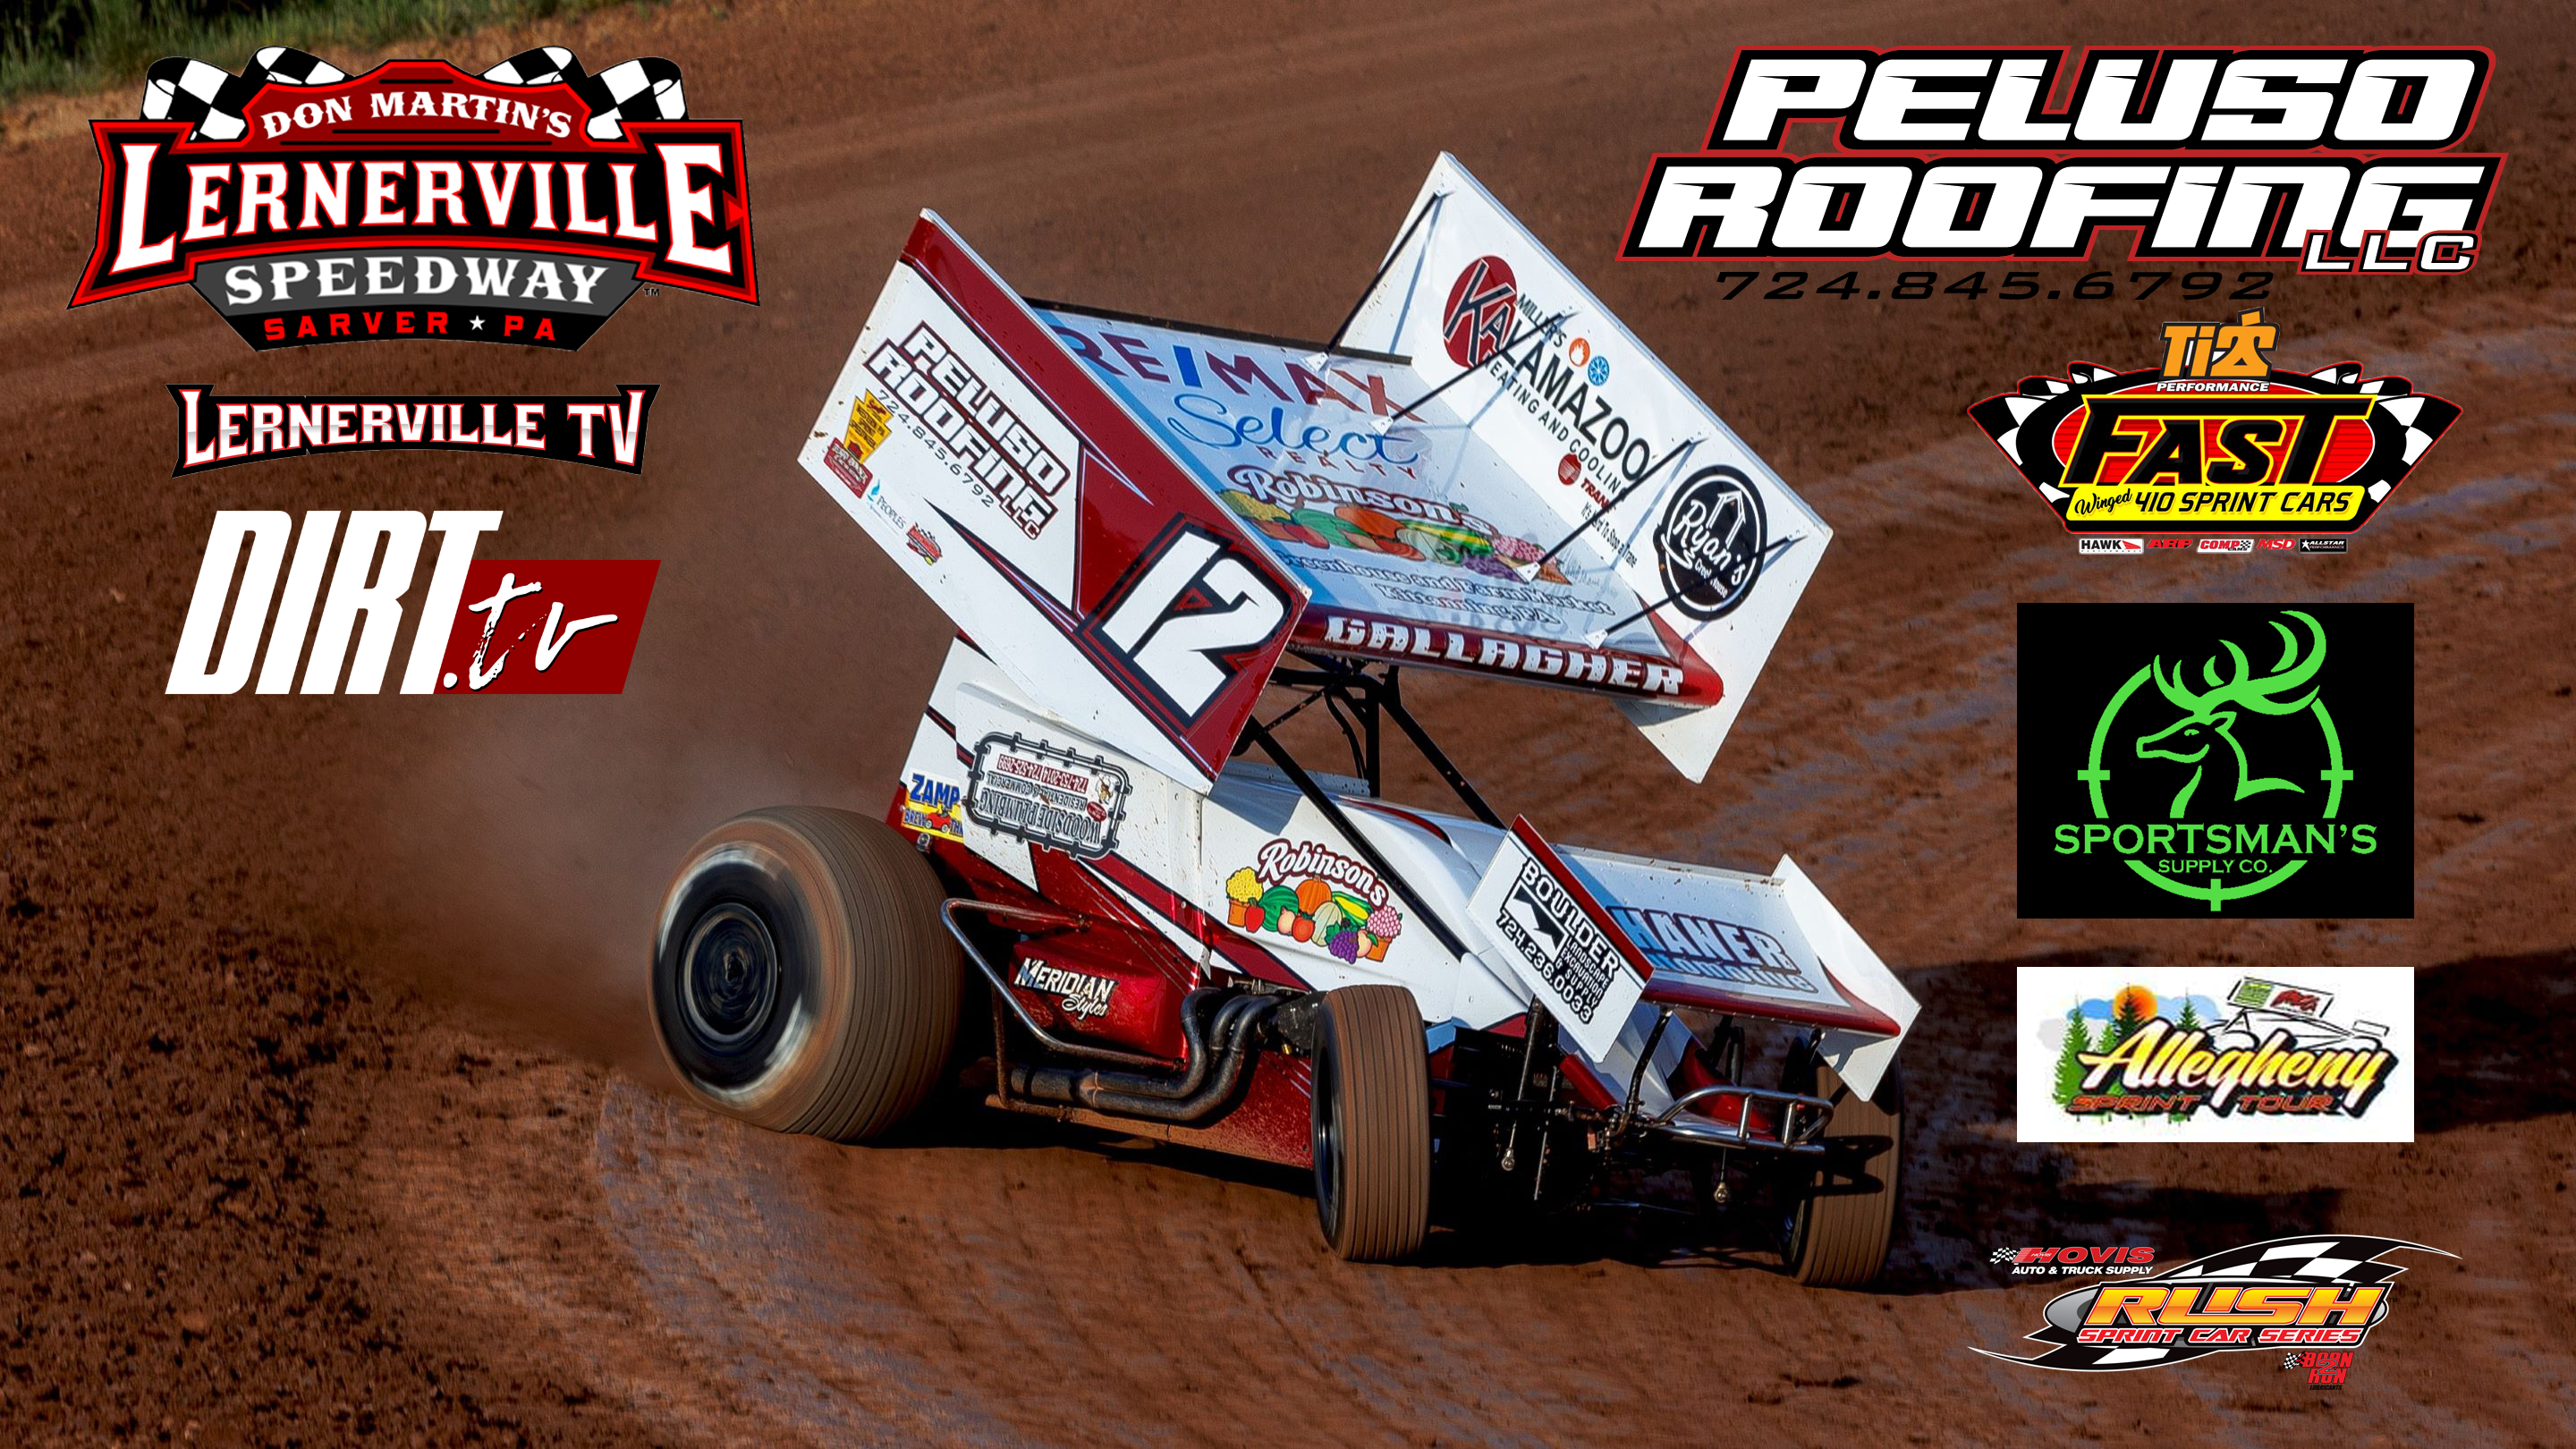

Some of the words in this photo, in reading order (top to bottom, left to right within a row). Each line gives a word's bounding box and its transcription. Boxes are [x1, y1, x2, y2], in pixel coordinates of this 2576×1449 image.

[1443, 258, 1651, 481] KALAMAZOO
[865, 341, 1055, 528] ROOFING
[902, 324, 1069, 495] PELUSO
[1167, 393, 1419, 464] Select
[1538, 411, 1570, 442] AND
[877, 389, 995, 508] 724.845.6792
[1254, 445, 1418, 480] REALTY
[877, 496, 907, 530] PEOPLES
[1001, 496, 1041, 540] LLC
[1672, 498, 1745, 586] Ryan's
[1101, 530, 1284, 717] 12
[1323, 615, 1685, 696] GALLAGHER
[911, 773, 962, 809] ZAMP
[979, 787, 1038, 826] PLUMBING
[986, 771, 1032, 795] COMMERCIAL
[1037, 804, 1100, 844] WOODSIDE
[1522, 860, 1620, 977] BOULDER
[1607, 905, 1799, 975] HANER
[1015, 957, 1115, 1002] MERIDIAN
[1497, 908, 1593, 1022] 724.236.0033
[1565, 936, 1609, 987] LANDSCAPE
[1061, 995, 1108, 1021] Styles
[1565, 967, 1600, 1008] SUPPLY
